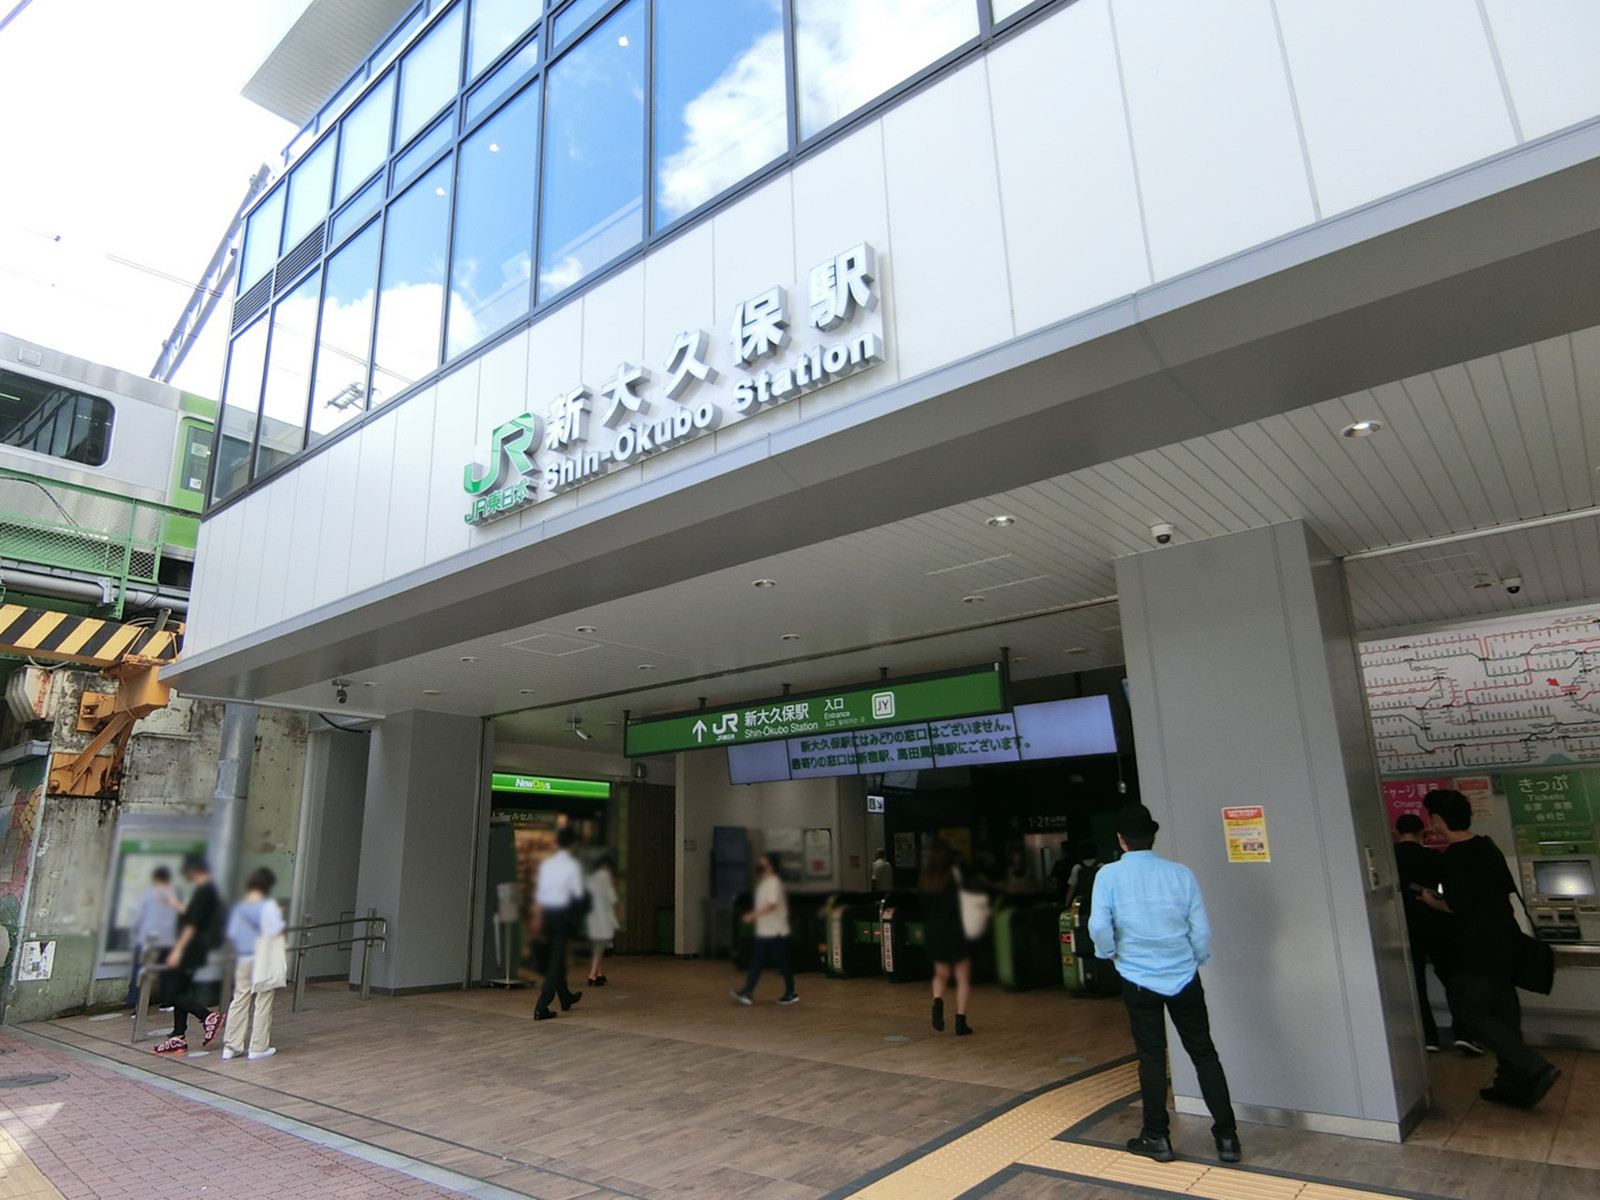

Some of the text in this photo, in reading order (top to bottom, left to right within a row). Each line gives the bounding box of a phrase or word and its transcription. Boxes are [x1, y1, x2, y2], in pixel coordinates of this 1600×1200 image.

[545, 240, 877, 454] 新大久保駅
[731, 331, 882, 414] Station
[463, 411, 541, 496] JR
[464, 479, 537, 524] JR東日本
[824, 697, 844, 712] 入口
[877, 698, 890, 712] JY
[712, 712, 739, 735] JR
[744, 702, 810, 727] 新大久保駅
[824, 711, 850, 721] Entrance
[790, 721, 819, 733] Station
[515, 778, 551, 790] NewDays
[1518, 774, 1569, 793] きっぷ
[1393, 800, 1423, 809] Charg
